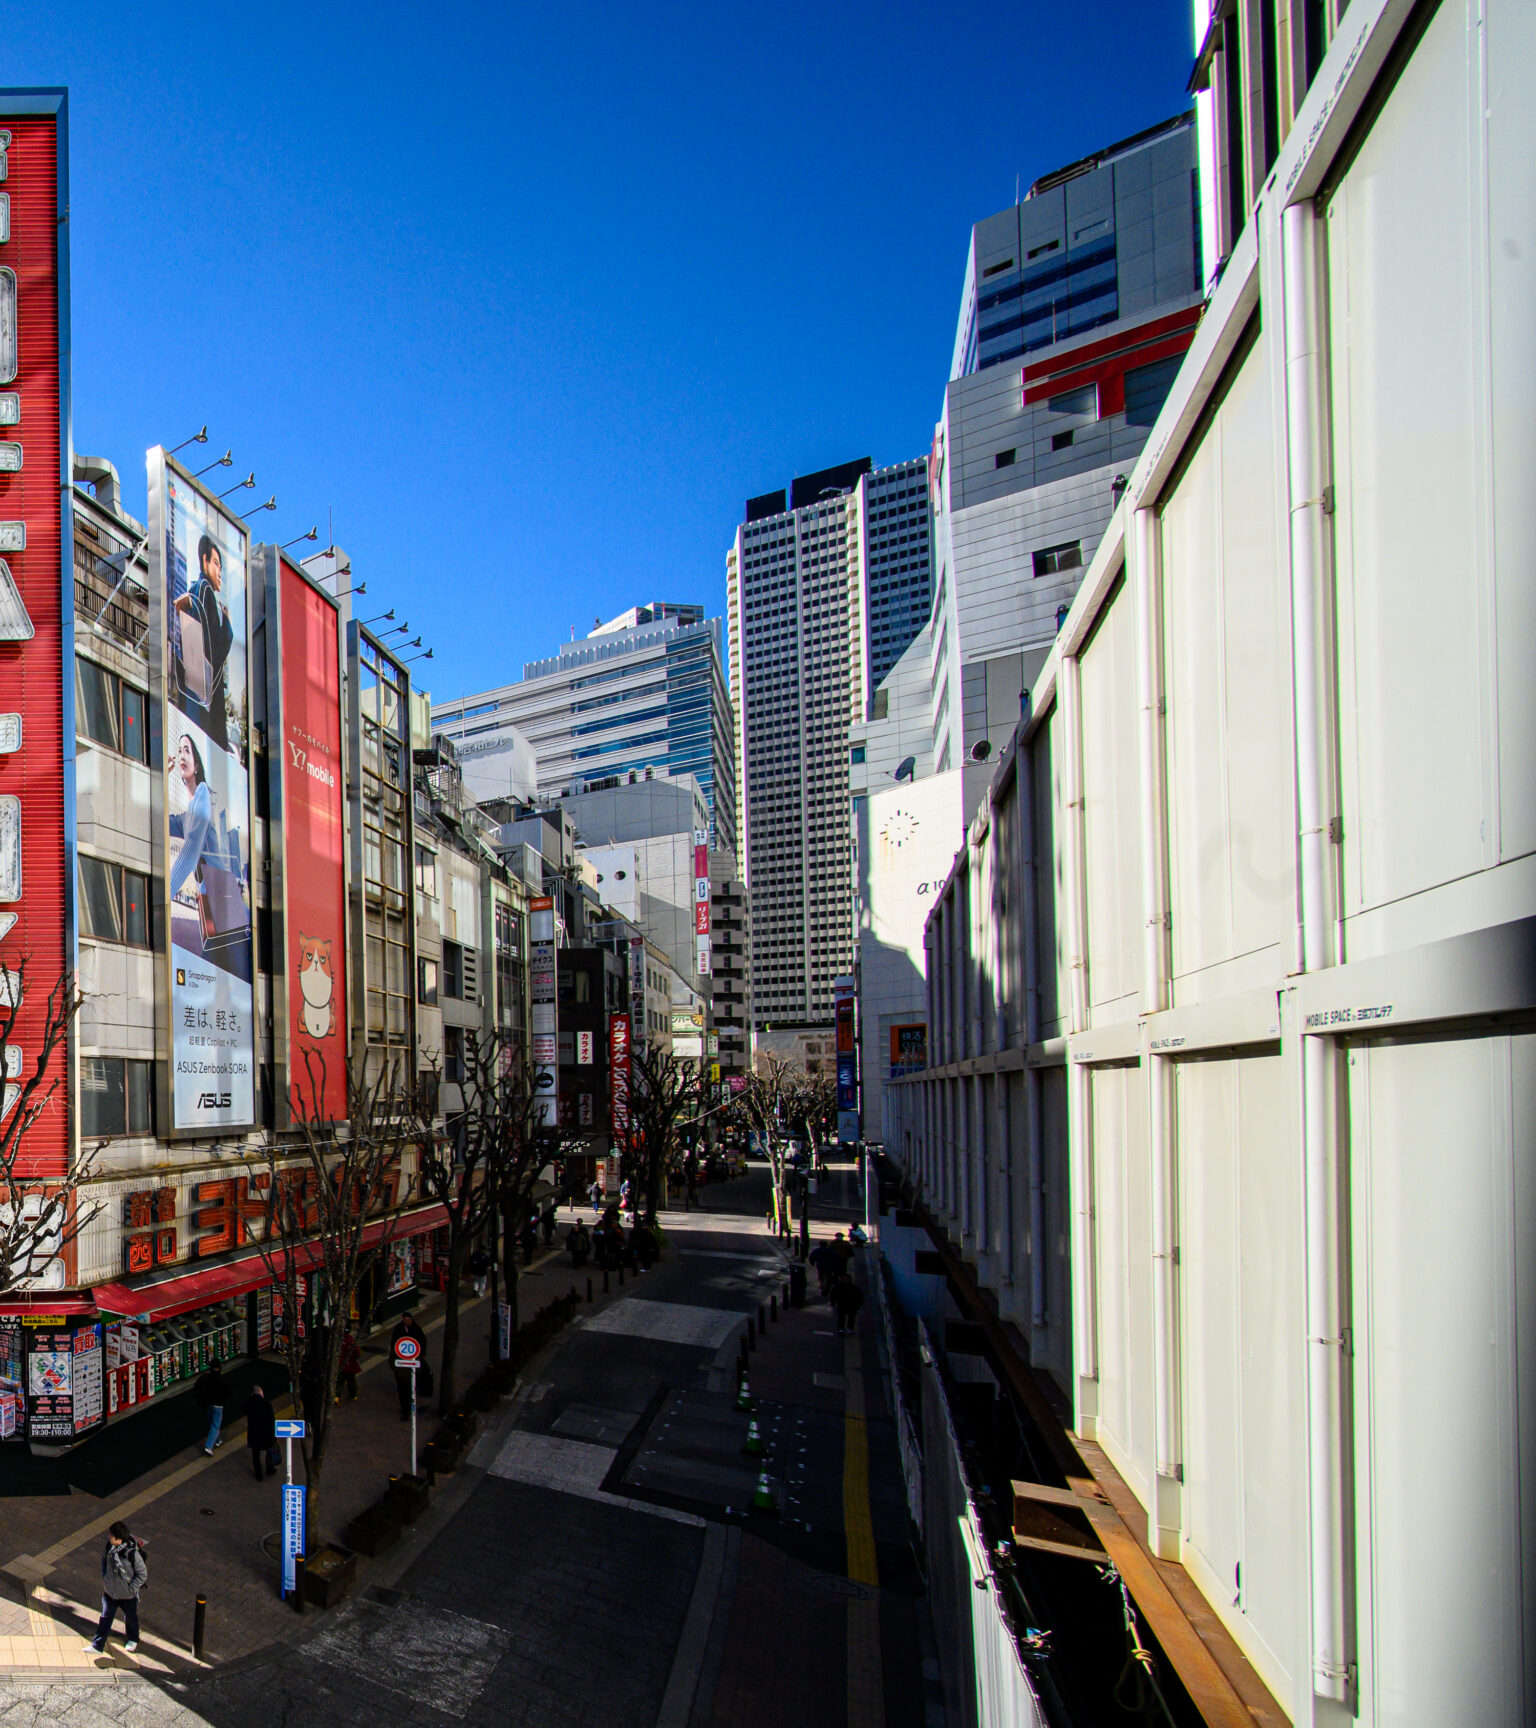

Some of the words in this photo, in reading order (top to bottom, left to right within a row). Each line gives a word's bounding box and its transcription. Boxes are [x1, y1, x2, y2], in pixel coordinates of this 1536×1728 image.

[292, 725, 330, 755] ヤフーのモバイル
[306, 761, 335, 788] mobile
[531, 956, 554, 965] テイクス
[188, 969, 216, 984] Snapdragon
[183, 1004, 242, 1033] 差は、軽さ。
[1304, 1011, 1329, 1027] MOBILE
[1330, 1008, 1351, 1025] SPACE
[581, 1033, 590, 1063] カラオケ
[613, 1020, 628, 1063] カラオケ
[177, 1060, 198, 1075] ASUS
[199, 1061, 228, 1075] Zenbook
[229, 1062, 248, 1075] SORA
[840, 1061, 852, 1086] AOKI
[197, 1093, 232, 1109] ASUS
[128, 1187, 177, 1228] 新宿
[128, 1226, 177, 1273] 西口
[73, 1333, 96, 1355] 買取
[400, 1343, 415, 1354] 20
